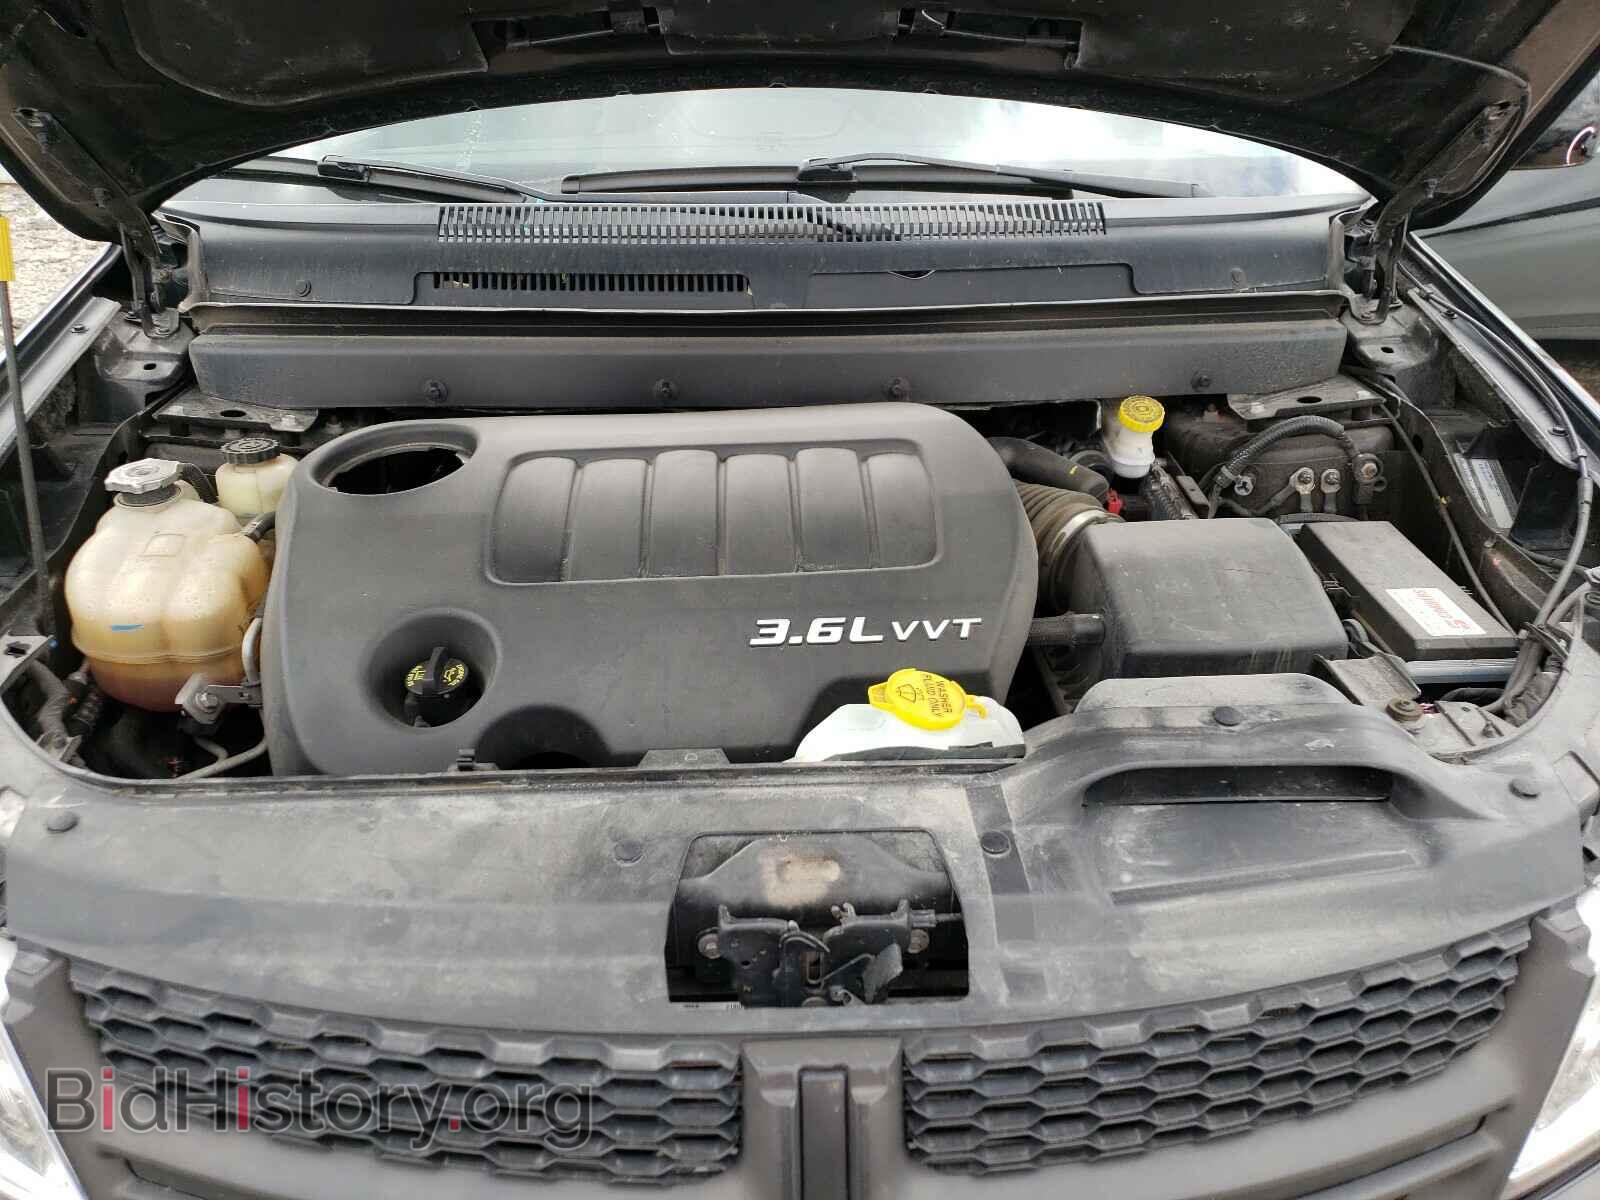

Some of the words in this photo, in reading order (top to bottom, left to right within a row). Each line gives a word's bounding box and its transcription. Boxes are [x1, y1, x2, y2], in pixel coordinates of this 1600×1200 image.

[750, 617, 883, 646] 3.6L
[892, 617, 982, 641] VVT
[936, 680, 953, 713] WASHER
